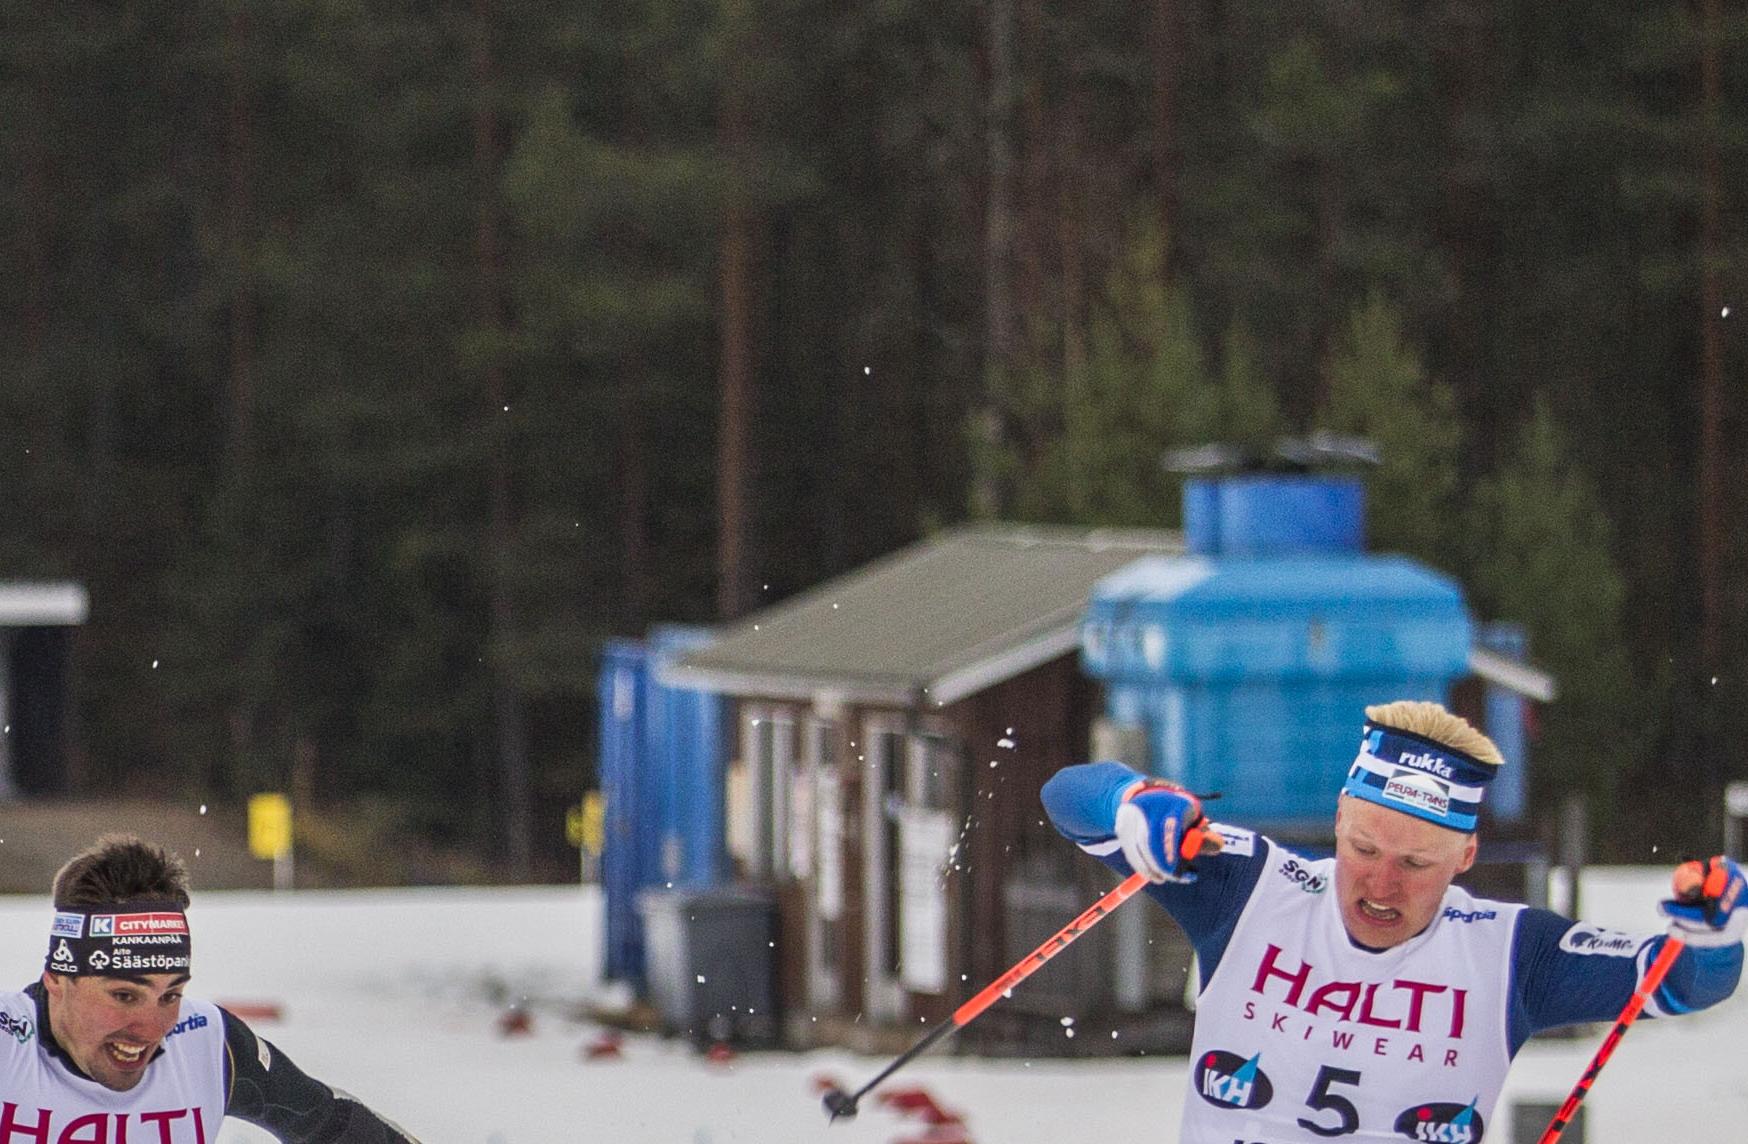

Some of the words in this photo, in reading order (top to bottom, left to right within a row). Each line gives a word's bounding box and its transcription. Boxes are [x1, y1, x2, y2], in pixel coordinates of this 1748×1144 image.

[1398, 751, 1453, 779] rukka
[93, 918, 110, 933] K
[1249, 943, 1468, 1040] HALTI
[1243, 1002, 1458, 1067] SKIWEAR
[1296, 1064, 1362, 1137] 5
